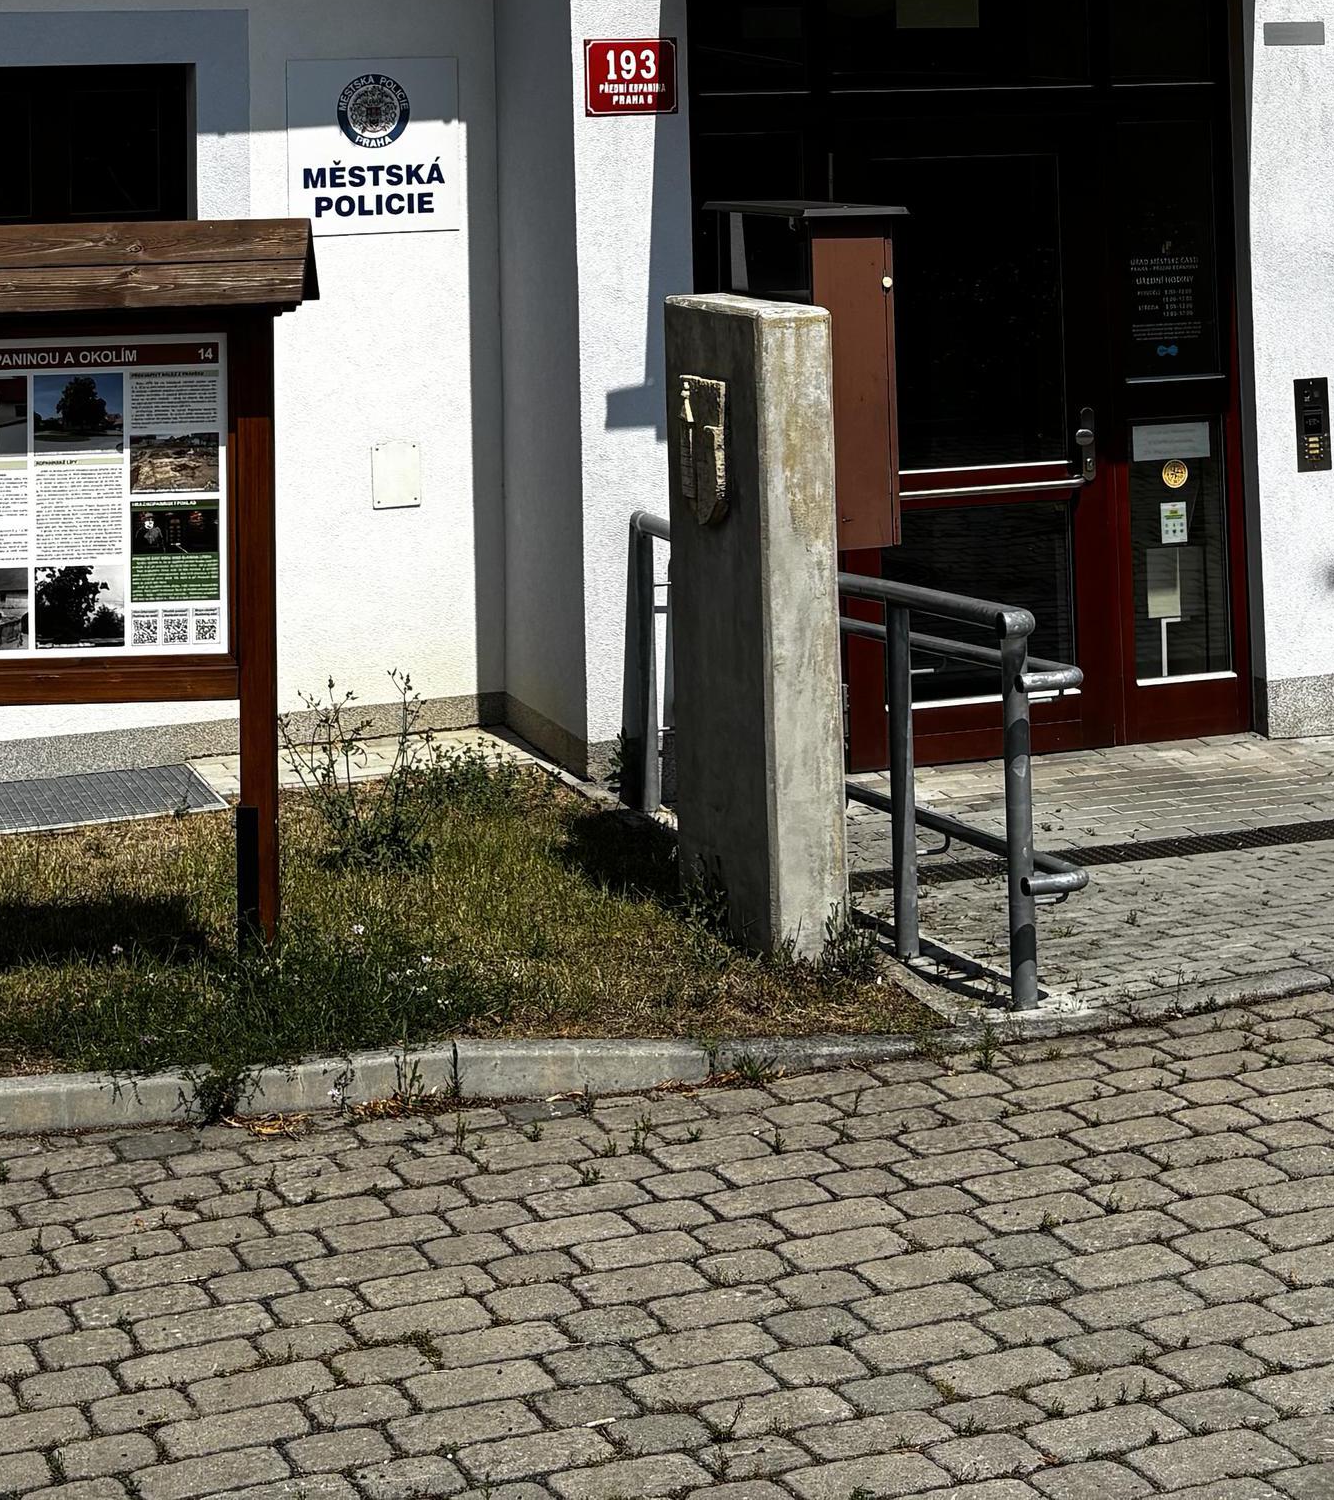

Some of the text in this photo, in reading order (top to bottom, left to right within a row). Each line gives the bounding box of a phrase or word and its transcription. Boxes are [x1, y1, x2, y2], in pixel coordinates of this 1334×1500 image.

[606, 49, 657, 80] 193
[380, 76, 409, 111] POLICIE
[612, 94, 653, 105] PRAHA 6
[355, 135, 393, 148] PRAHA
[303, 156, 445, 189] MĚSTSKÁ
[315, 192, 435, 218] POLICIE
[64, 352, 74, 365] A
[79, 347, 137, 364] OKOLÍM
[198, 347, 213, 360] 14
